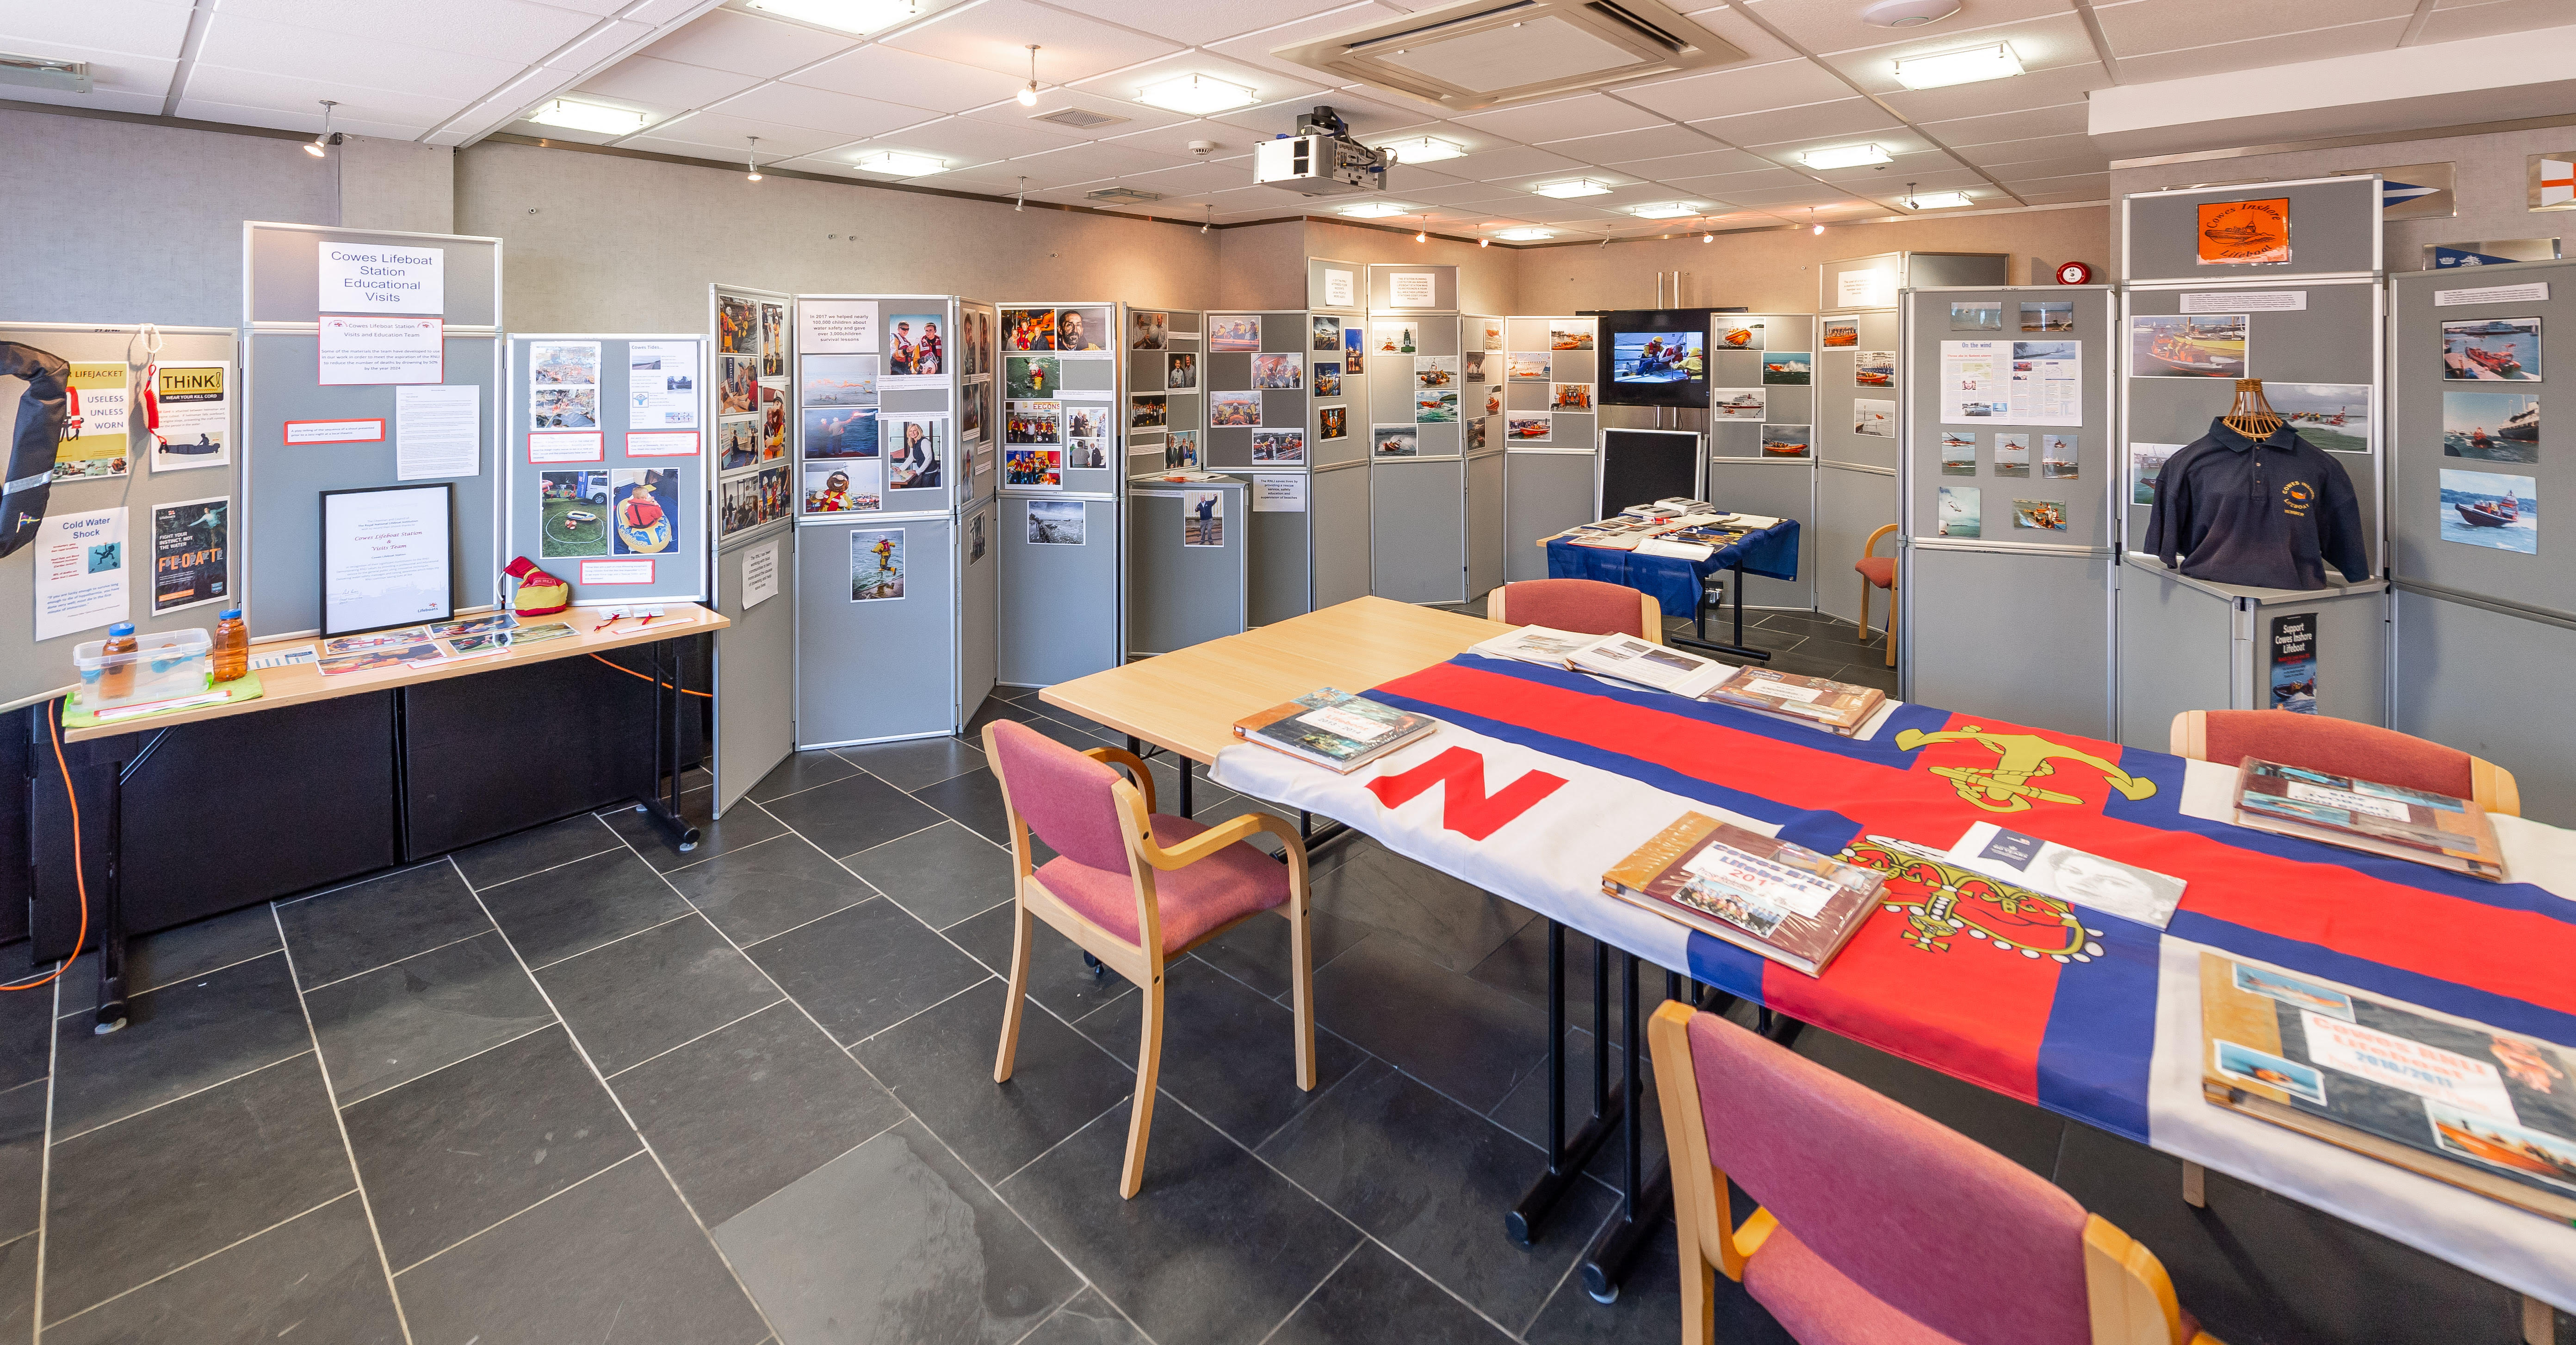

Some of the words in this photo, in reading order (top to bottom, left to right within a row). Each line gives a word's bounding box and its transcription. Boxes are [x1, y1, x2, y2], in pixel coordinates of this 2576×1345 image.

[2207, 207, 2236, 228] Cowes
[2241, 204, 2281, 220] Inshore
[331, 251, 377, 262] Cowes
[382, 254, 433, 265] Lifeboat
[2220, 245, 2272, 258] Lifeboat
[360, 266, 405, 276] Station
[344, 278, 420, 290] Educational
[365, 292, 400, 302] Visits
[75, 370, 123, 378] LIFEJACKET
[2282, 481, 2300, 494] COWES
[2284, 499, 2309, 509] LIFEBOAT
[63, 521, 83, 530] Cold
[86, 518, 110, 526] Water
[73, 529, 100, 539] Shock
[2283, 623, 2304, 635] Support
[2276, 636, 2292, 644] Cowes
[2293, 632, 2312, 642] Inshore
[2283, 642, 2305, 653] Lifeboat
[1325, 715, 1368, 730] Lifeboat
[1365, 746, 1570, 841] N
[1713, 844, 1781, 872] Cowes
[1786, 870, 1835, 891] RNLI
[1729, 869, 1775, 887] 201
[2313, 1016, 2410, 1053] Cowes
[2418, 1046, 2486, 1075] RNLI
[2333, 1034, 2463, 1080] Lifeboat
[2356, 1051, 2454, 1087] 2010/2011
